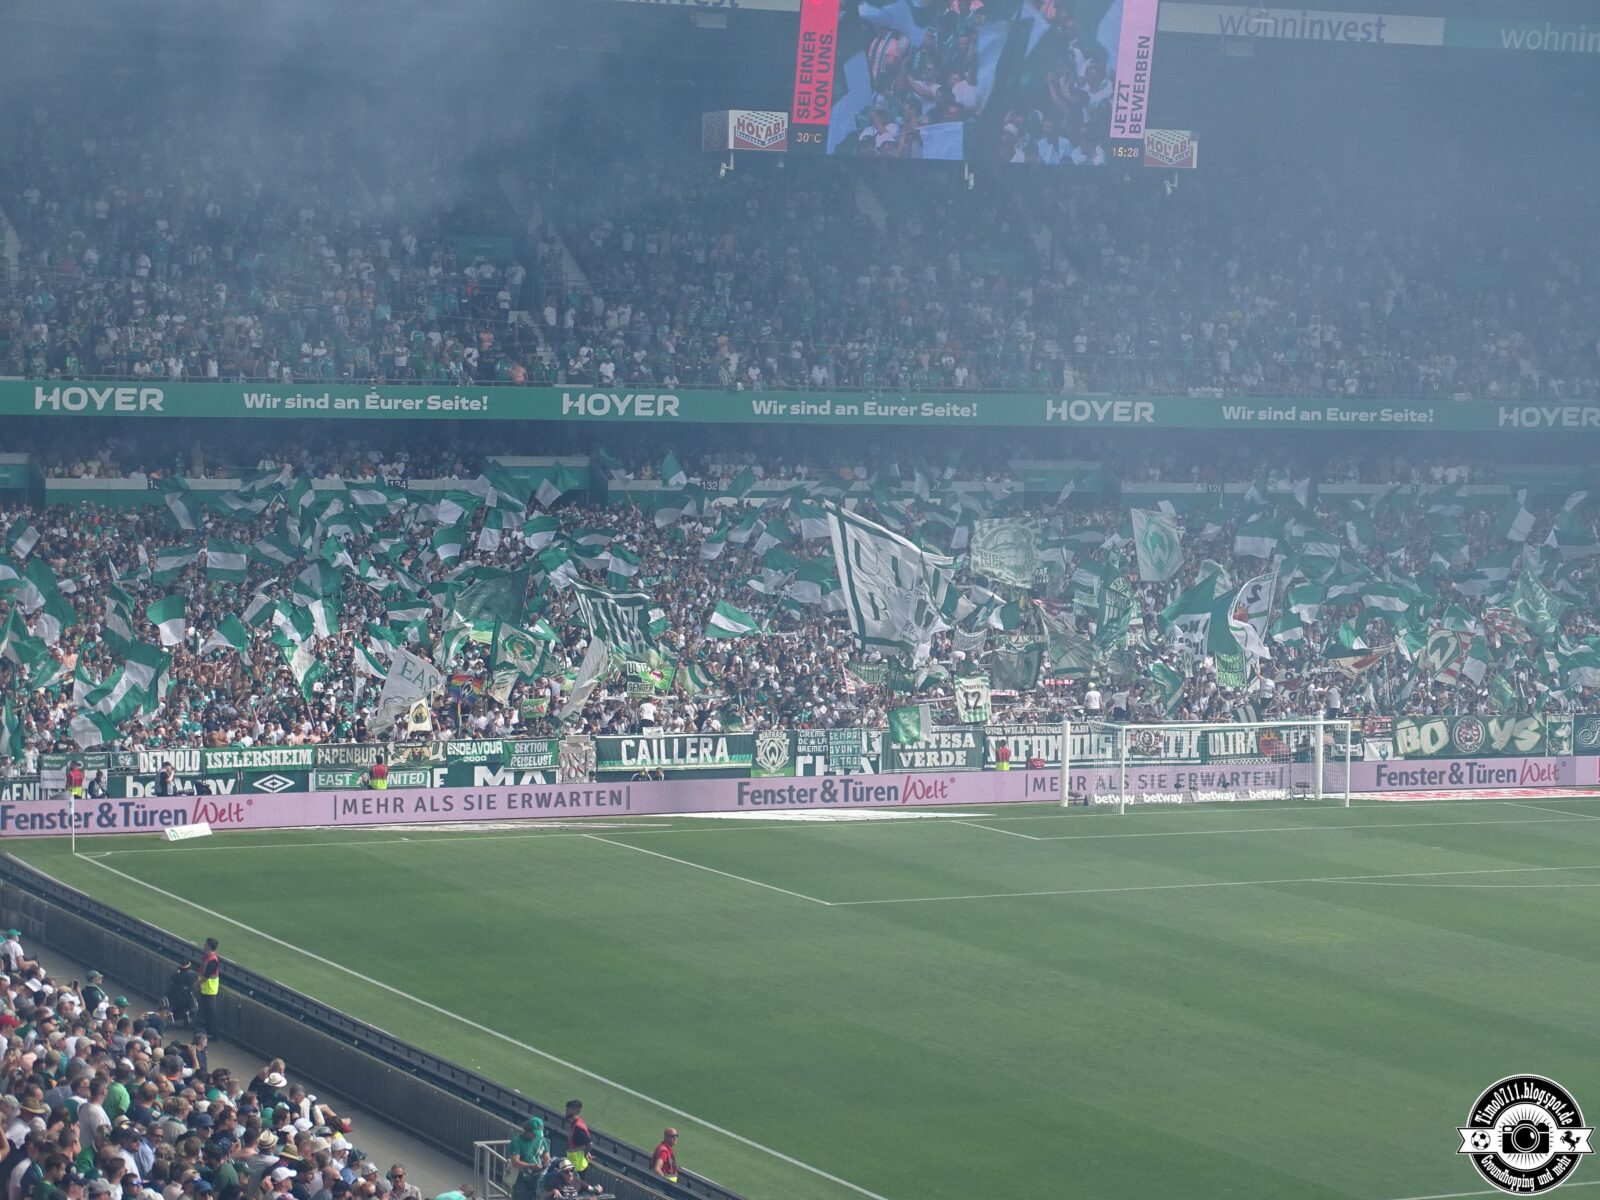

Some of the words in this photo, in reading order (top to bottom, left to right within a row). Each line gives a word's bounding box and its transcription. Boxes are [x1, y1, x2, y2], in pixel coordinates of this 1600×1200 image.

[1218, 9, 1387, 43] wohninvest
[800, 31, 817, 86] EINER
[1114, 81, 1130, 134] JETZT
[1129, 36, 1150, 134] BEWERBEN
[797, 91, 812, 119] SEI
[813, 80, 829, 120] VON
[35, 387, 164, 411] HOYER
[243, 393, 282, 410] Wir
[285, 392, 329, 410] sind
[334, 397, 360, 410] an
[365, 393, 424, 411] Eurer
[426, 395, 489, 411] Seite!
[562, 393, 680, 417] HOYER
[752, 399, 786, 416] Wir
[790, 400, 831, 416] sind
[835, 404, 858, 416] an
[864, 402, 917, 417] Eurer
[921, 402, 978, 418] Seite!
[1046, 399, 1155, 423] HOYER
[1222, 406, 1254, 421] Wir
[1258, 406, 1296, 422] sind
[1300, 409, 1322, 421] an
[1327, 407, 1378, 422] Eurer
[1381, 408, 1434, 423] Seite!
[963, 691, 981, 710] 12
[317, 747, 384, 765] PAPENBURG
[447, 741, 503, 755] ENDEAVOUR
[514, 742, 548, 754] SEKTION
[621, 737, 730, 766] CAILLERA
[205, 749, 313, 769] ISELERSHEIM
[510, 754, 553, 768] REISELUST
[899, 751, 967, 768] VERDE
[318, 774, 352, 786] EAST
[386, 772, 425, 785] NITED
[1138, 773, 1167, 789] SIE
[342, 797, 404, 815] MEHR
[414, 795, 454, 812] ALS
[463, 793, 497, 810] SIE
[507, 790, 622, 810] ERWARTEN
[1143, 792, 1183, 803] betway
